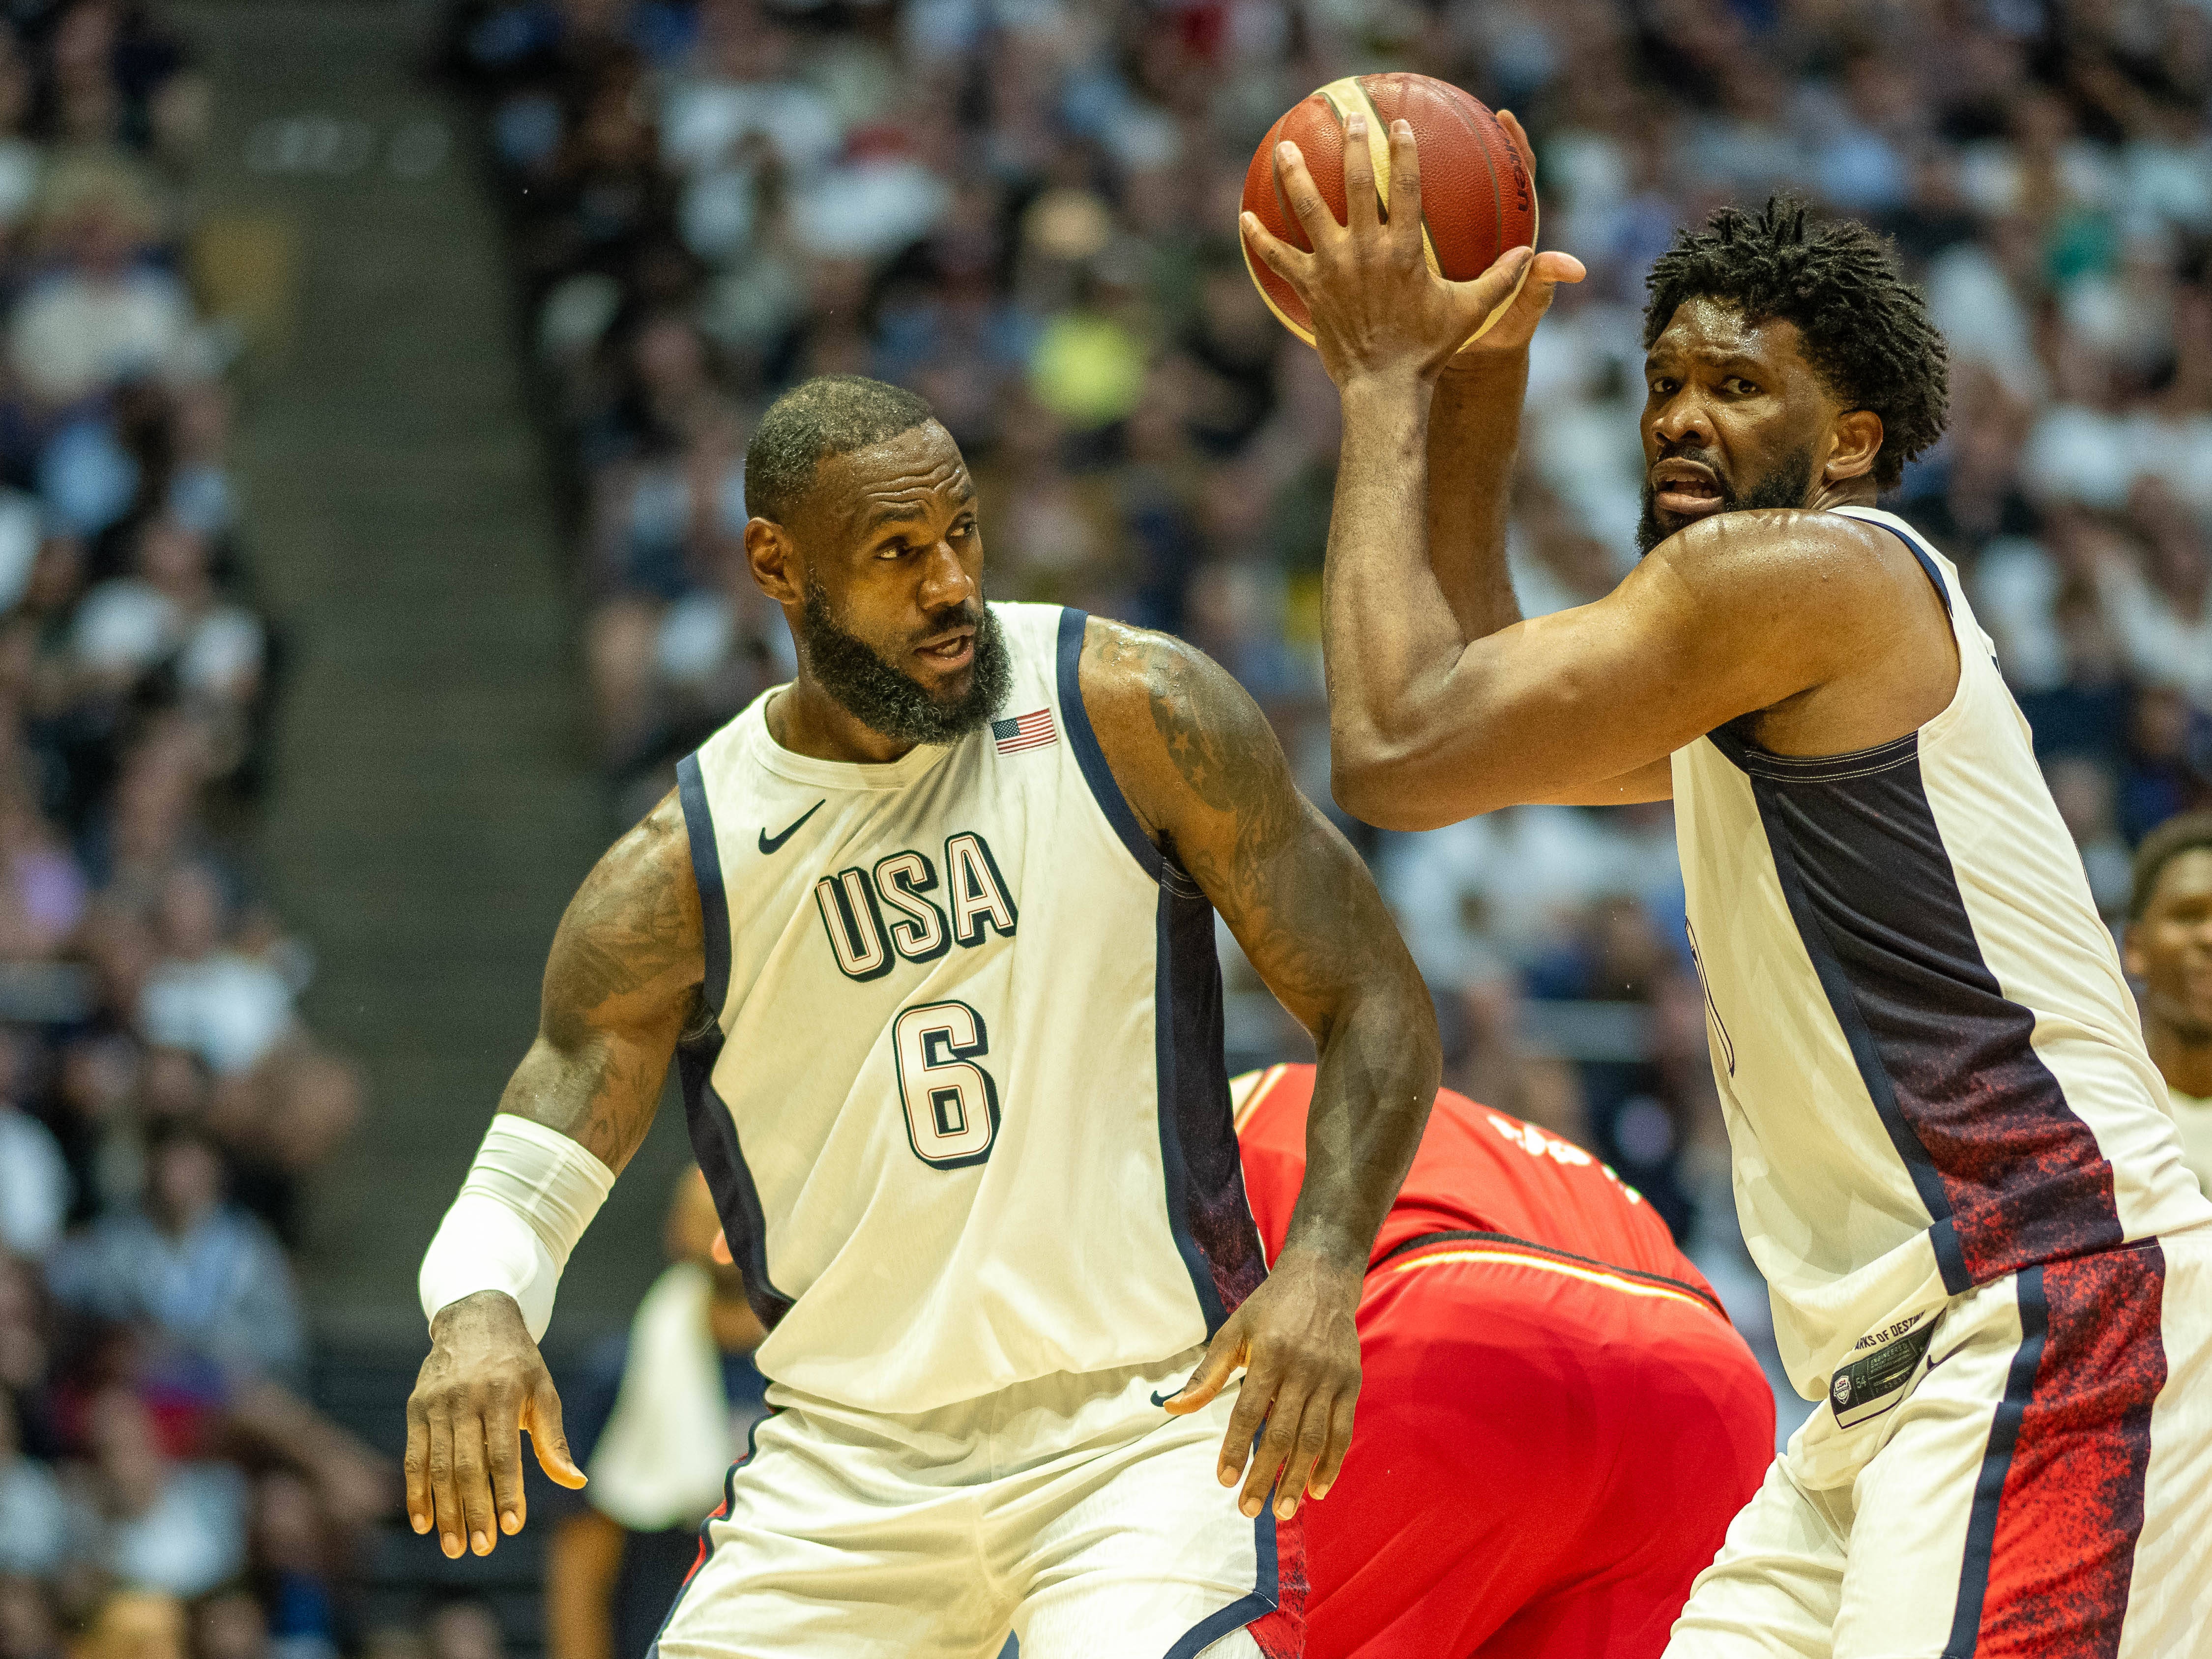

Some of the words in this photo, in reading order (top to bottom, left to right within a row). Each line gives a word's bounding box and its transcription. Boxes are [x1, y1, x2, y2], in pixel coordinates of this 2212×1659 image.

[815, 831, 1018, 983] USA
[892, 1000, 1001, 1170] 6
[1876, 1330, 1890, 1342] OF
[1856, 1376, 1866, 1389] 54
